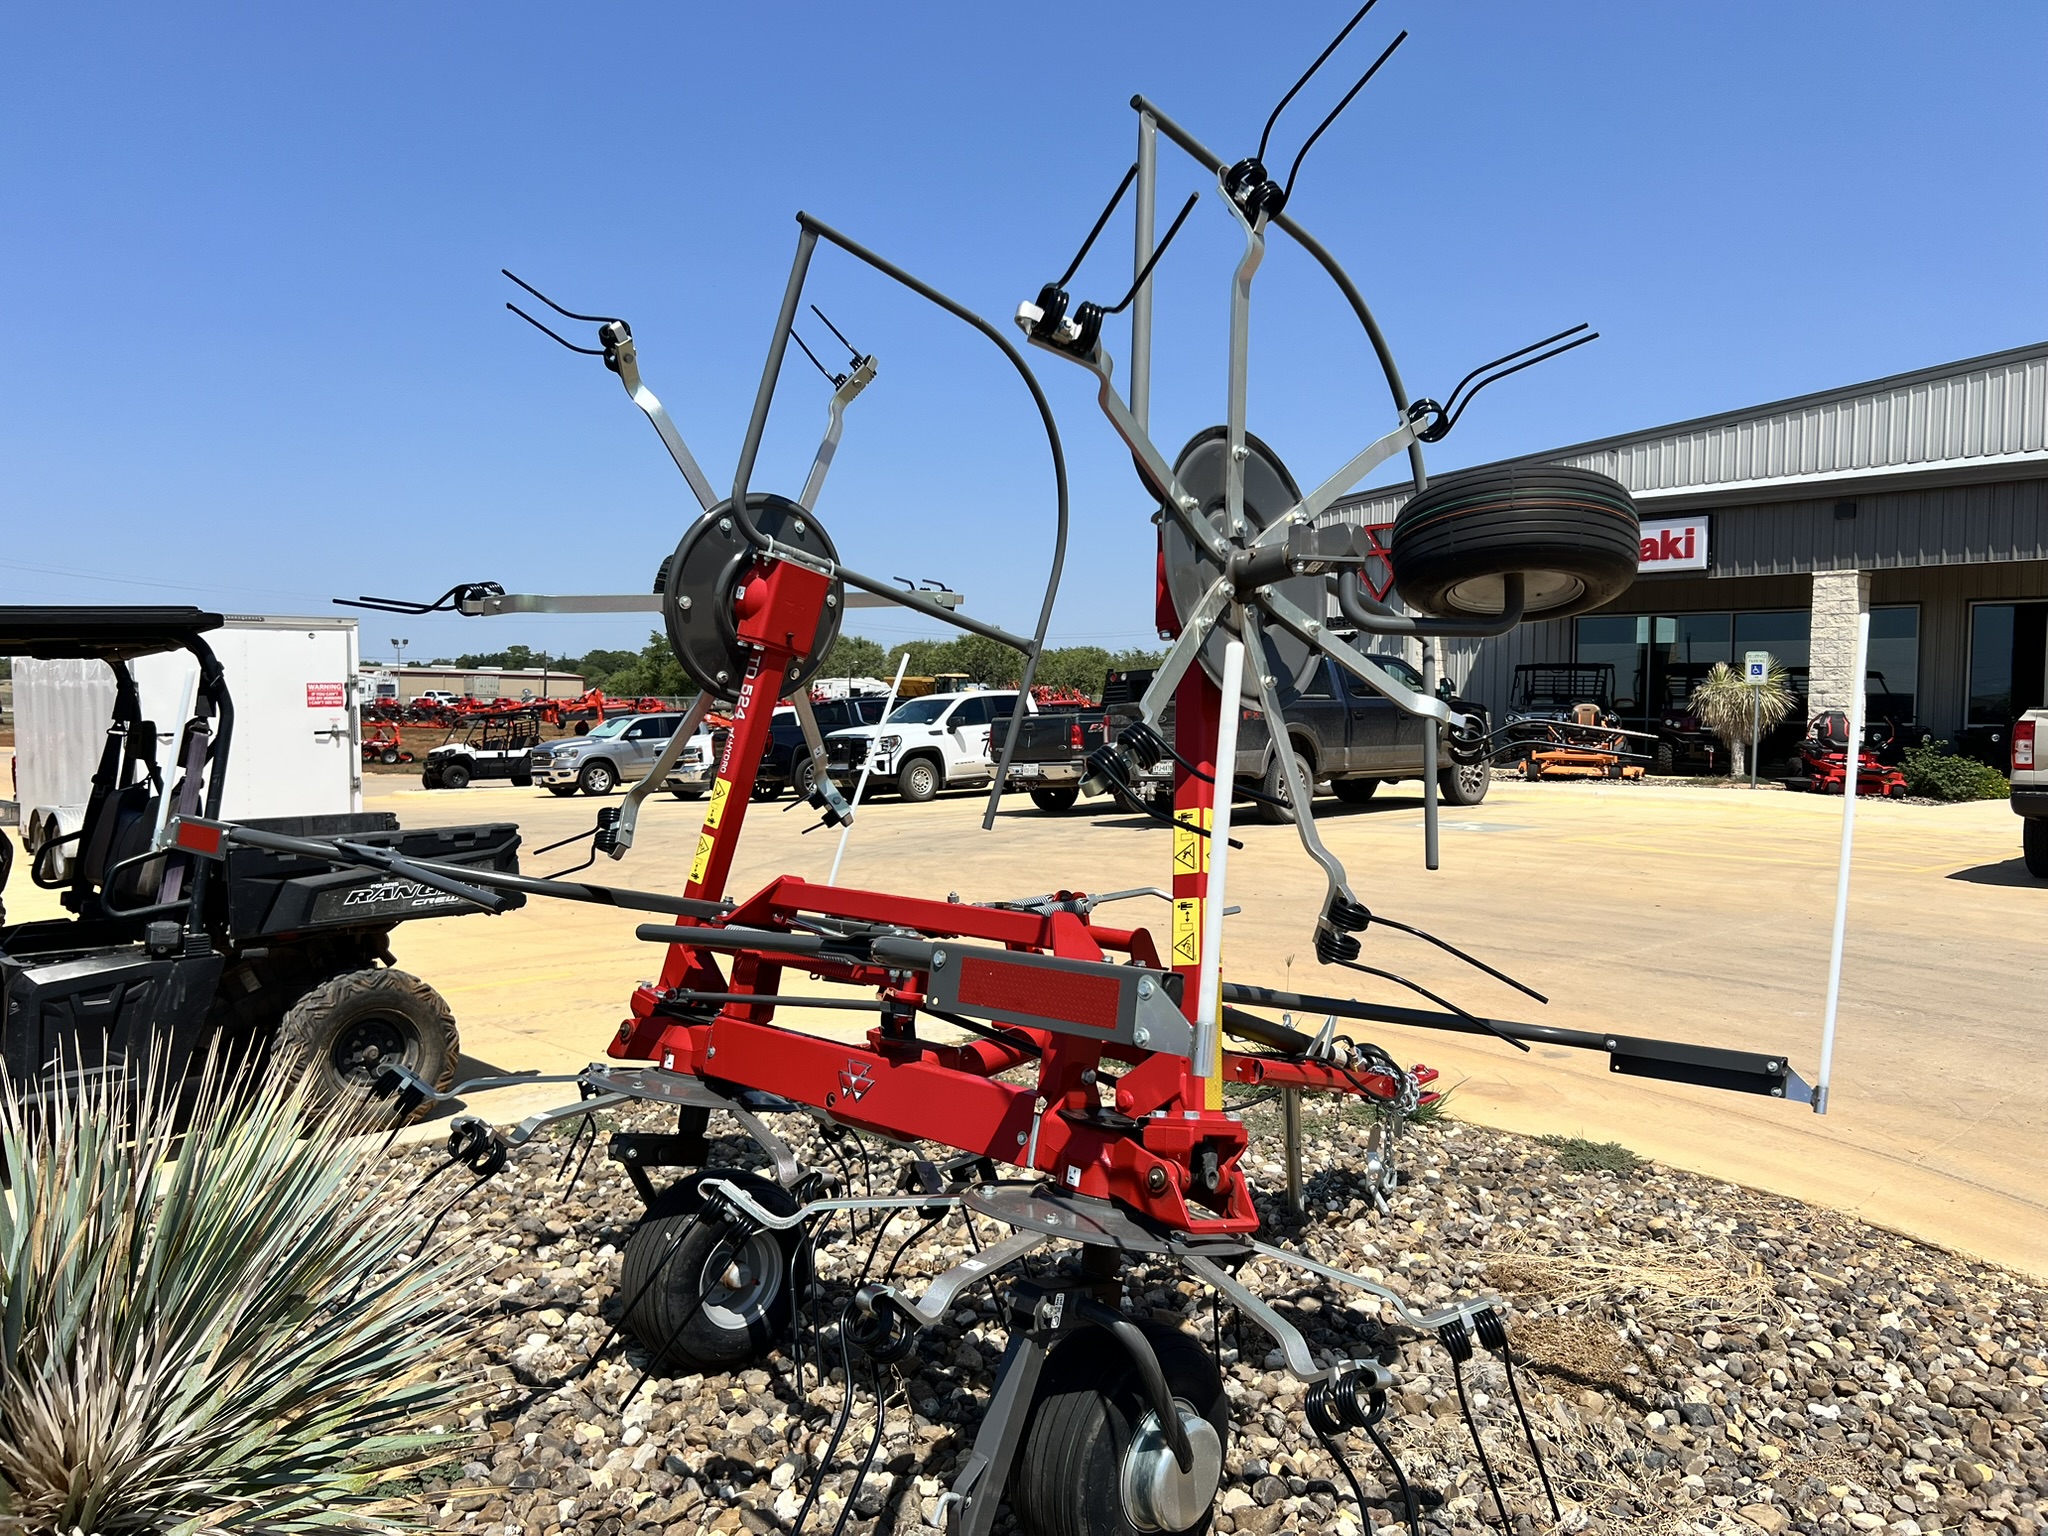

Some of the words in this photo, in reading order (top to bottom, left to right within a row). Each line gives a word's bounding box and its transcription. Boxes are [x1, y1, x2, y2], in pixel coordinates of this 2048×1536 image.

[1639, 527, 1695, 562] aki
[746, 656, 761, 680] TD
[735, 684, 753, 720] 524
[411, 895, 459, 906] CREW
